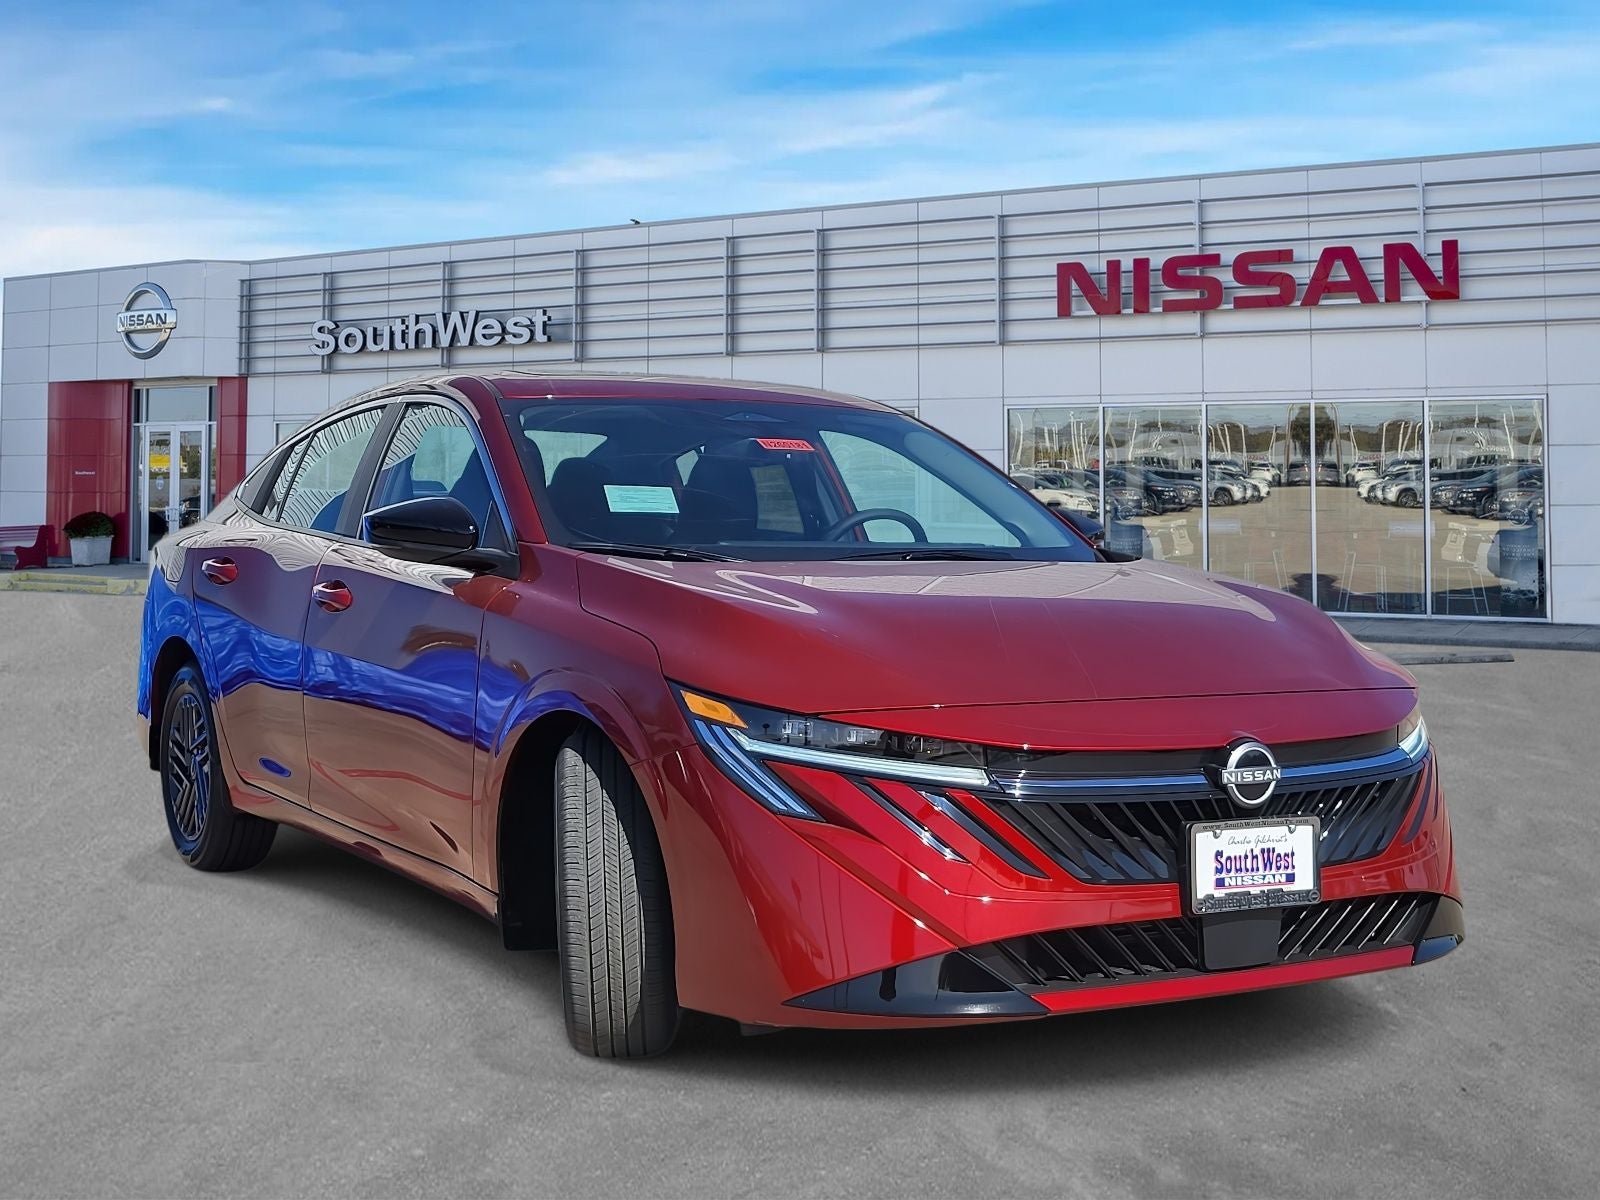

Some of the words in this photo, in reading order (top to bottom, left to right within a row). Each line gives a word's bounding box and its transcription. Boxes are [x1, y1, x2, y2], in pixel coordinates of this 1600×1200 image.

[1056, 239, 1460, 318] NISSAN
[118, 313, 168, 327] NISSAN
[310, 309, 551, 355] SouthWest
[1223, 769, 1281, 783] NISSAN
[1214, 846, 1295, 875] SouthWest
[1224, 873, 1287, 887] NISSAN
